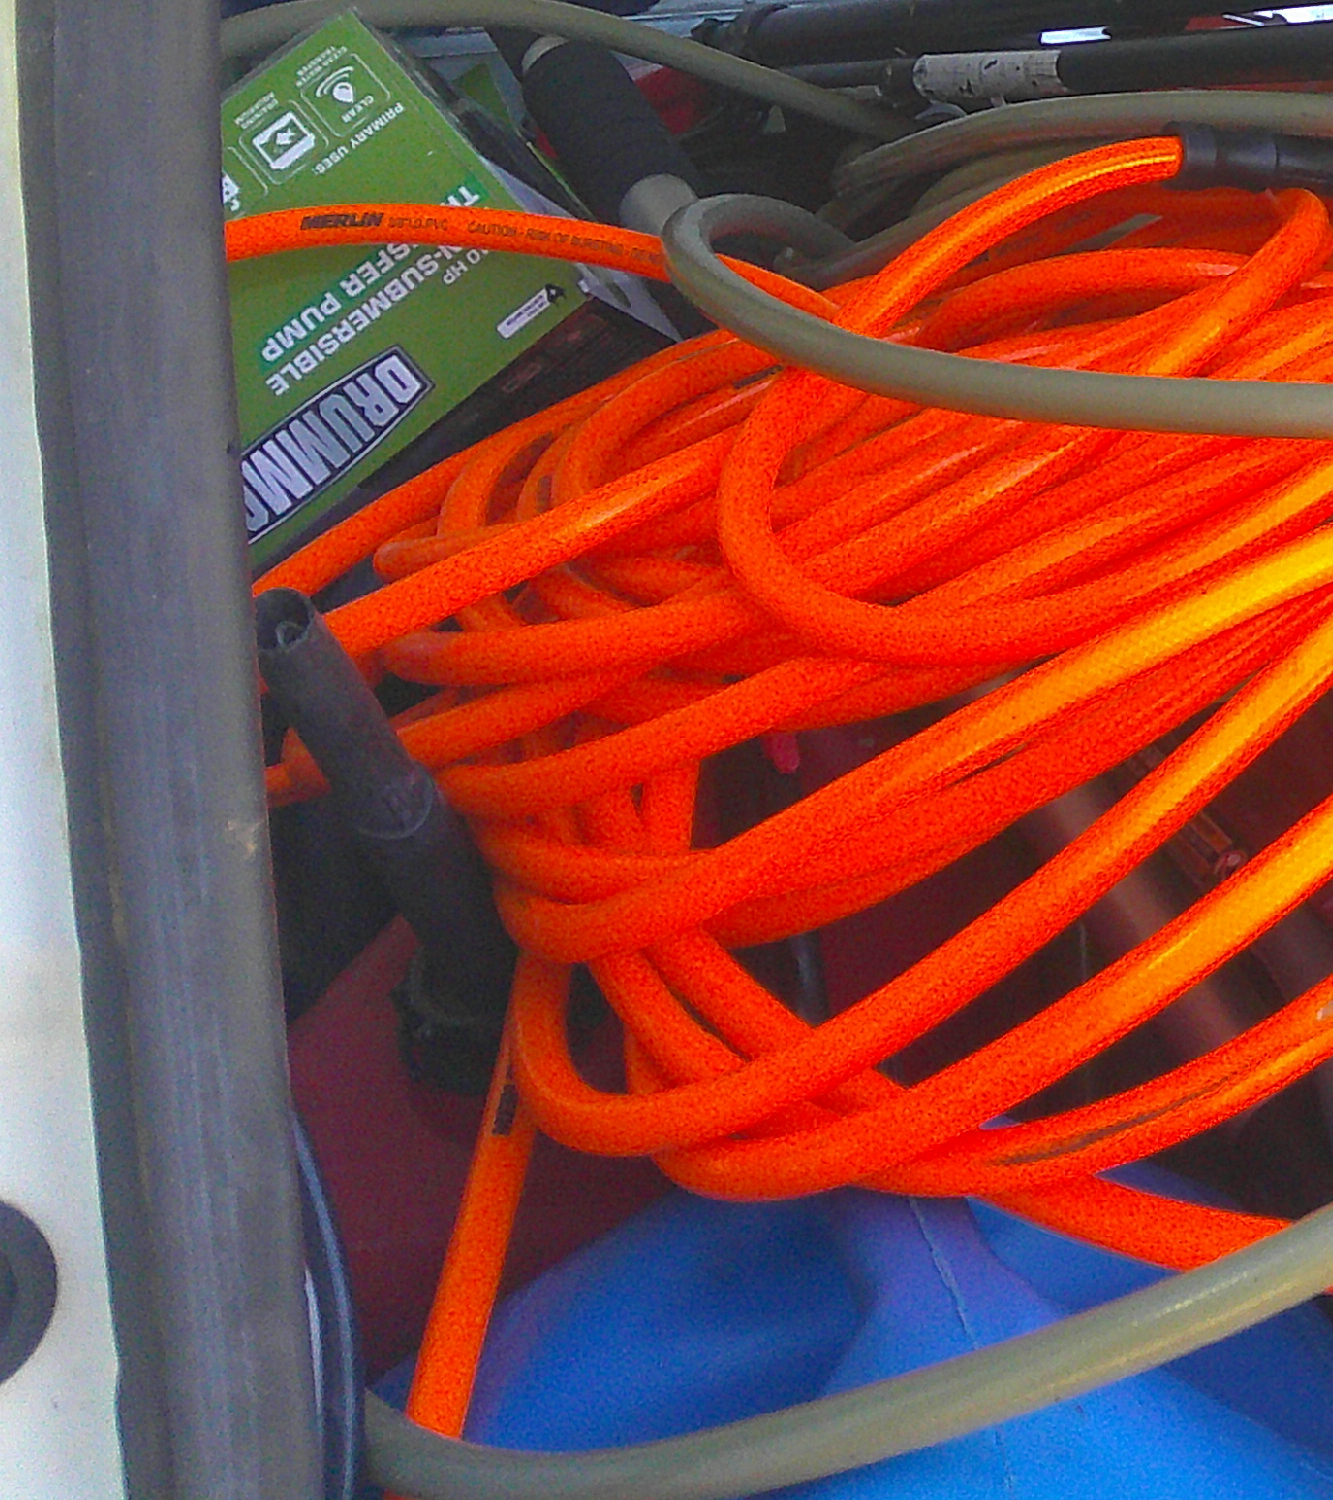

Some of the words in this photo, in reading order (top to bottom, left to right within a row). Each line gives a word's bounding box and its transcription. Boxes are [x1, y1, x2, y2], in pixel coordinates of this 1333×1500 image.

[340, 95, 375, 124] CLEAR
[349, 101, 405, 150] PRIMARY
[300, 212, 384, 231] MERLIN
[466, 220, 518, 238] CAUTION
[260, 290, 343, 363] PUMP
